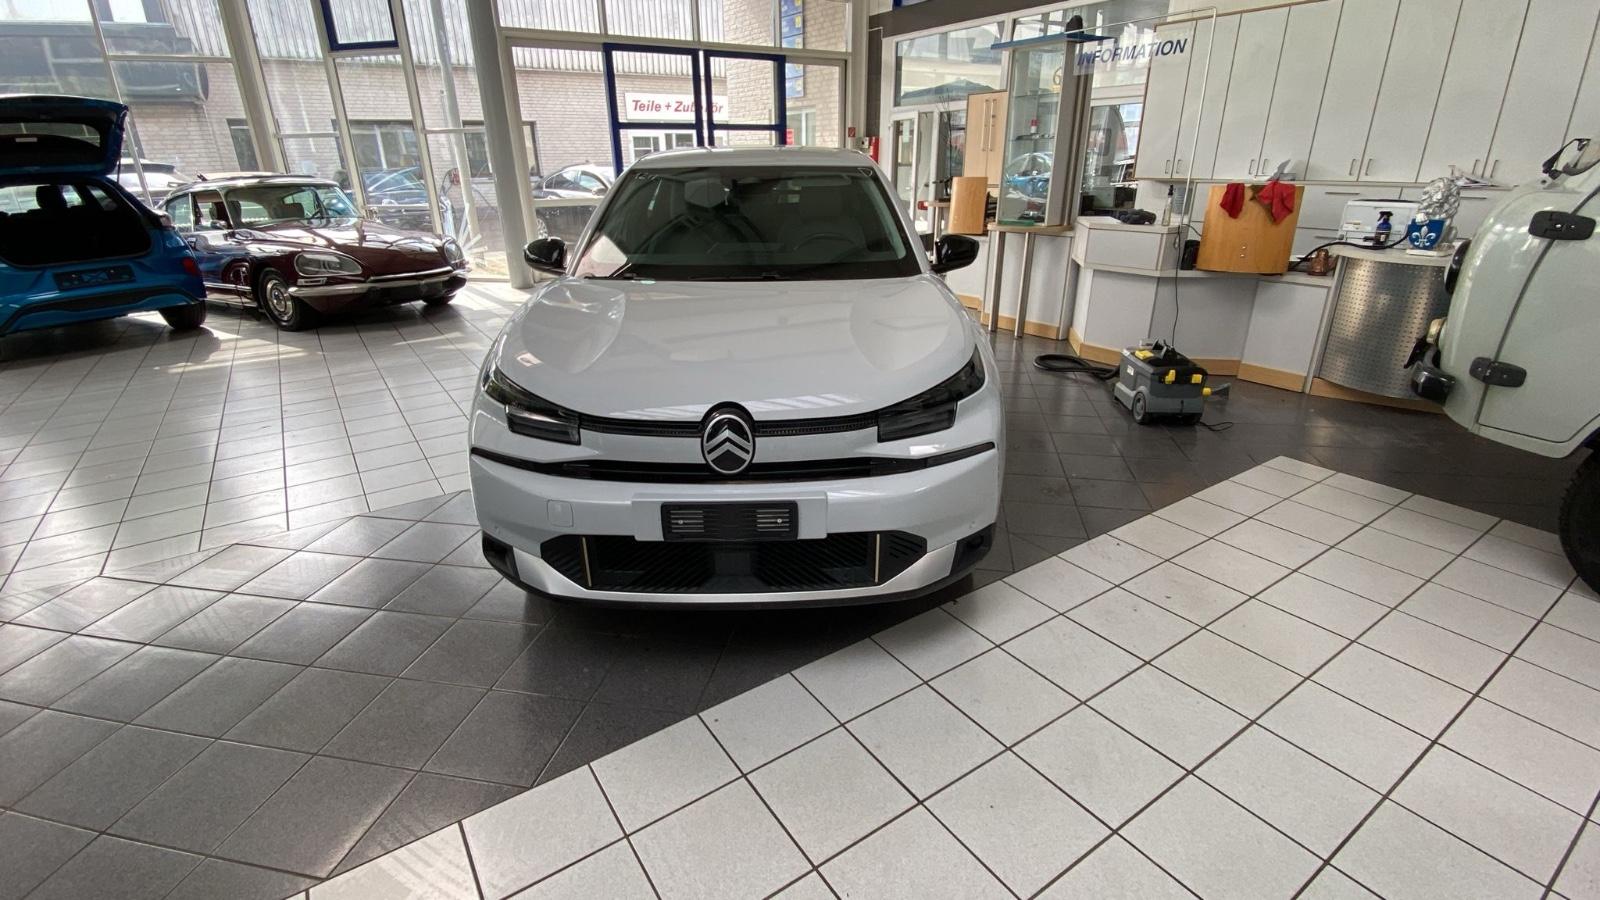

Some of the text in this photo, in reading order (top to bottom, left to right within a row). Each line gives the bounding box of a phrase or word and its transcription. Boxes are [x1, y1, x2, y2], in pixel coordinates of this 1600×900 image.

[1077, 38, 1188, 66] INFORMATION
[632, 99, 724, 113] Teile + Zubör
